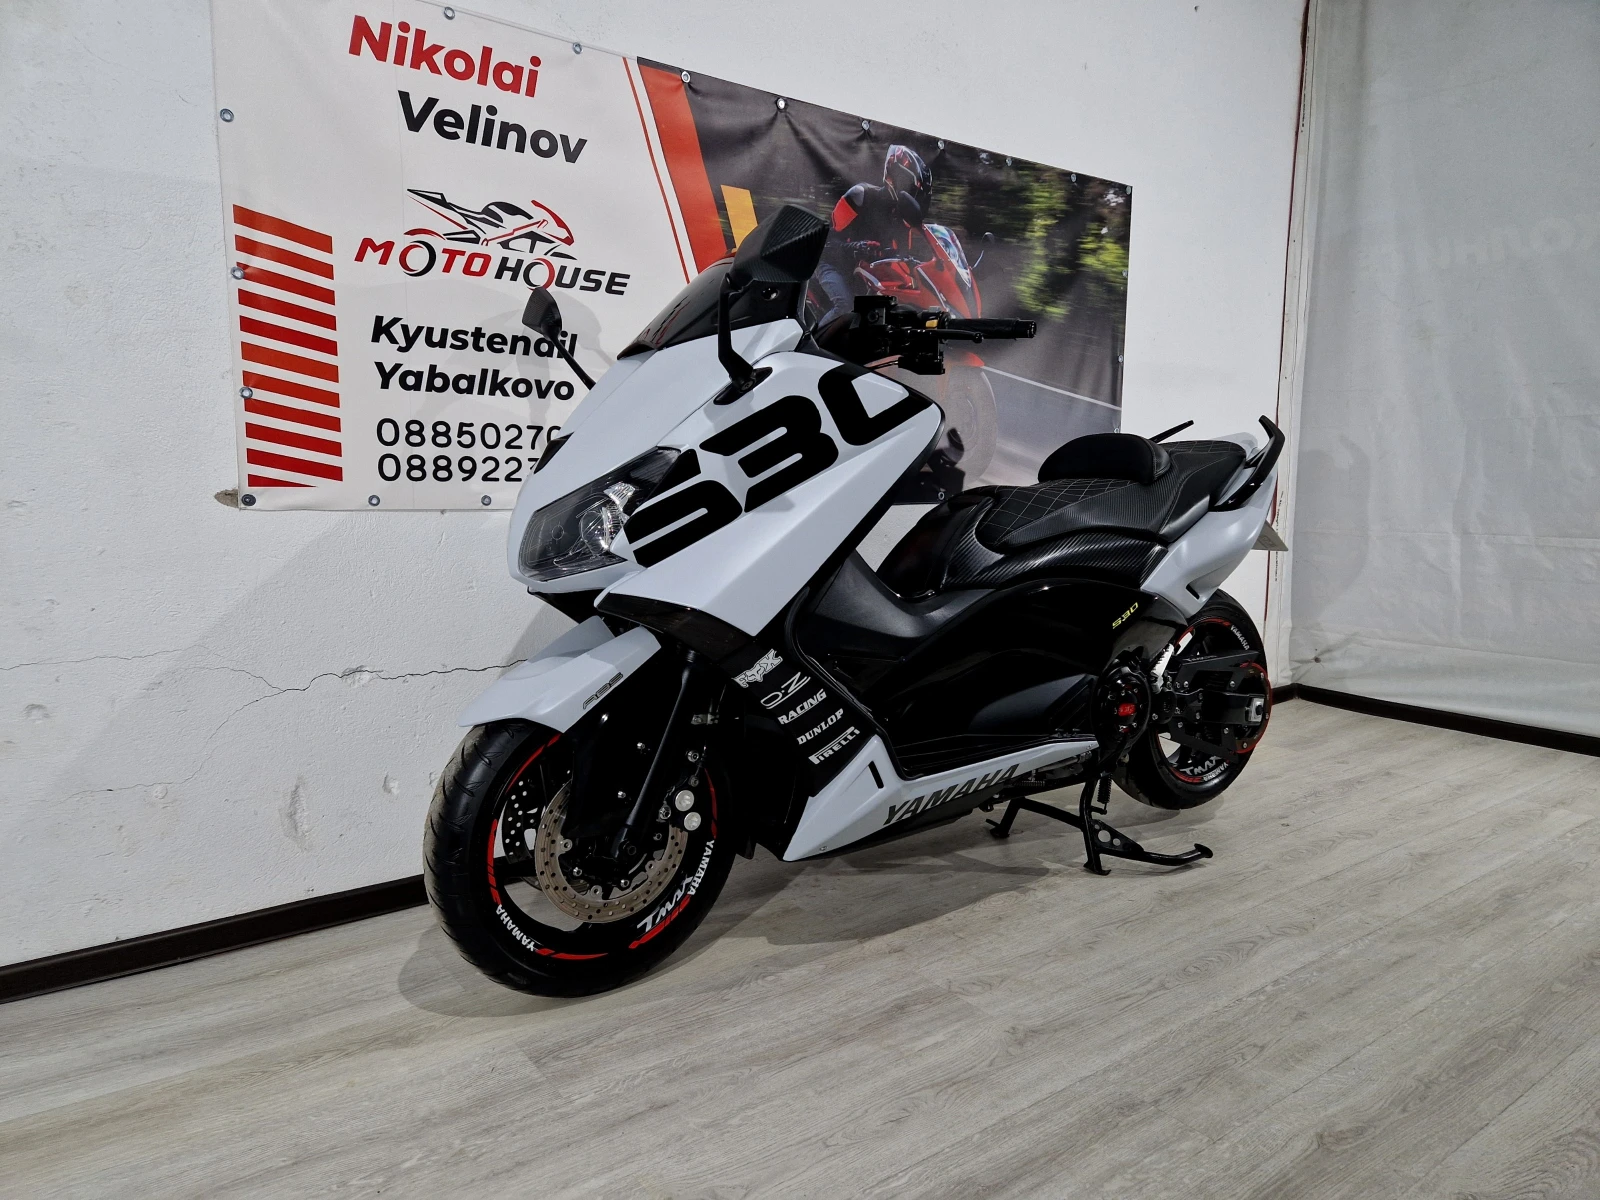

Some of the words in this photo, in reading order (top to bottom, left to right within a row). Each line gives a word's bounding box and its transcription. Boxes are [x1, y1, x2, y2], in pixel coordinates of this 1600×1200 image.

[348, 14, 542, 98] Nikolai
[397, 89, 588, 164] Velinov
[374, 361, 575, 401] Yabalkovo
[1229, 624, 1250, 651] YAMAHA
[777, 688, 827, 725] RACING
[796, 708, 844, 745] DUNLOP
[808, 726, 860, 765] PIRELLI
[882, 763, 1021, 826] YAMAHA
[687, 839, 715, 896] YAMAHA
[495, 904, 537, 952] YAMAHA
